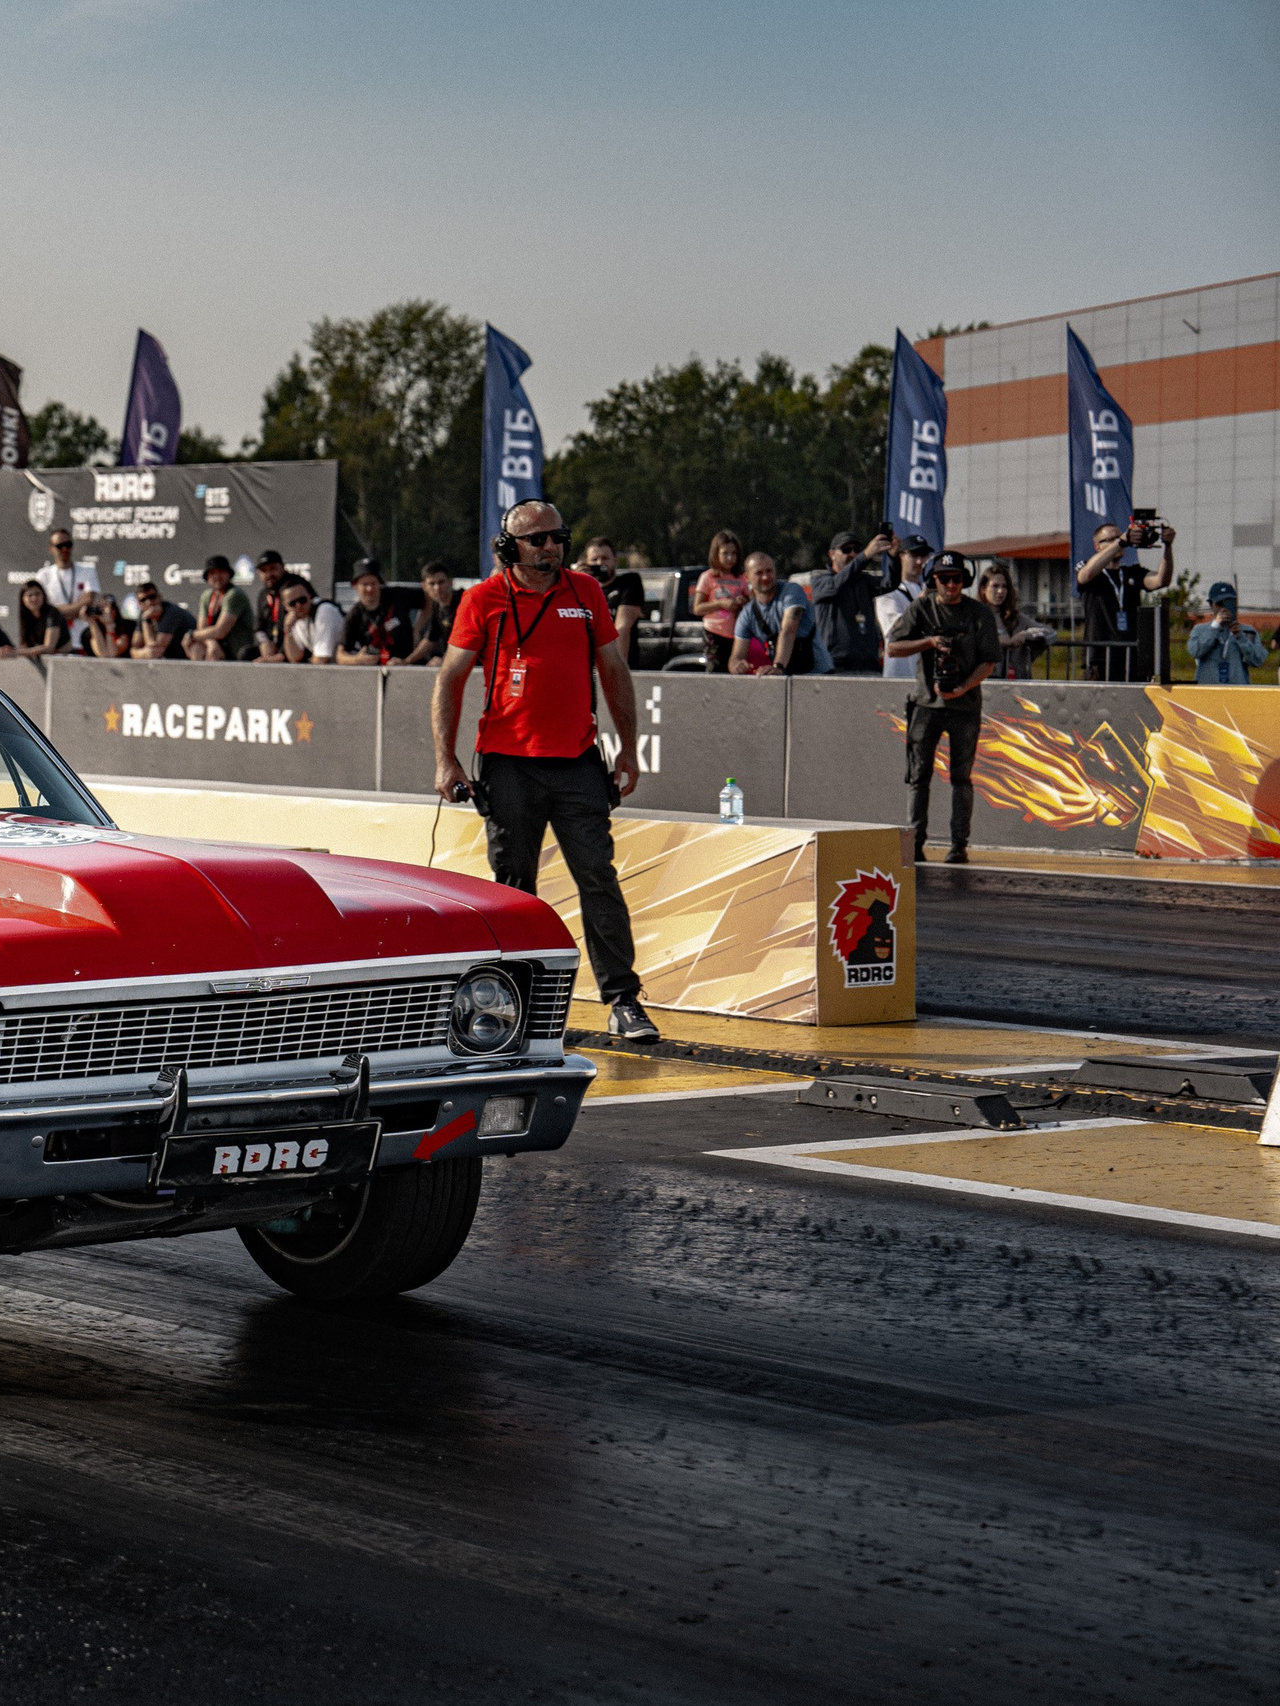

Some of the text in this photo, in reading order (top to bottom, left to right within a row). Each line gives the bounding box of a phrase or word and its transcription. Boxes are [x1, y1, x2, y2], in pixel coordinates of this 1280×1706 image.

[136, 419, 169, 466] ТБ
[501, 407, 535, 480] ВТБ
[909, 418, 941, 492] ВТБ
[1088, 408, 1121, 480] ВТБ
[122, 702, 294, 746] RACEPARK
[598, 732, 661, 774] NKI
[847, 965, 894, 984] RDRC
[212, 1138, 329, 1176] RDRC
